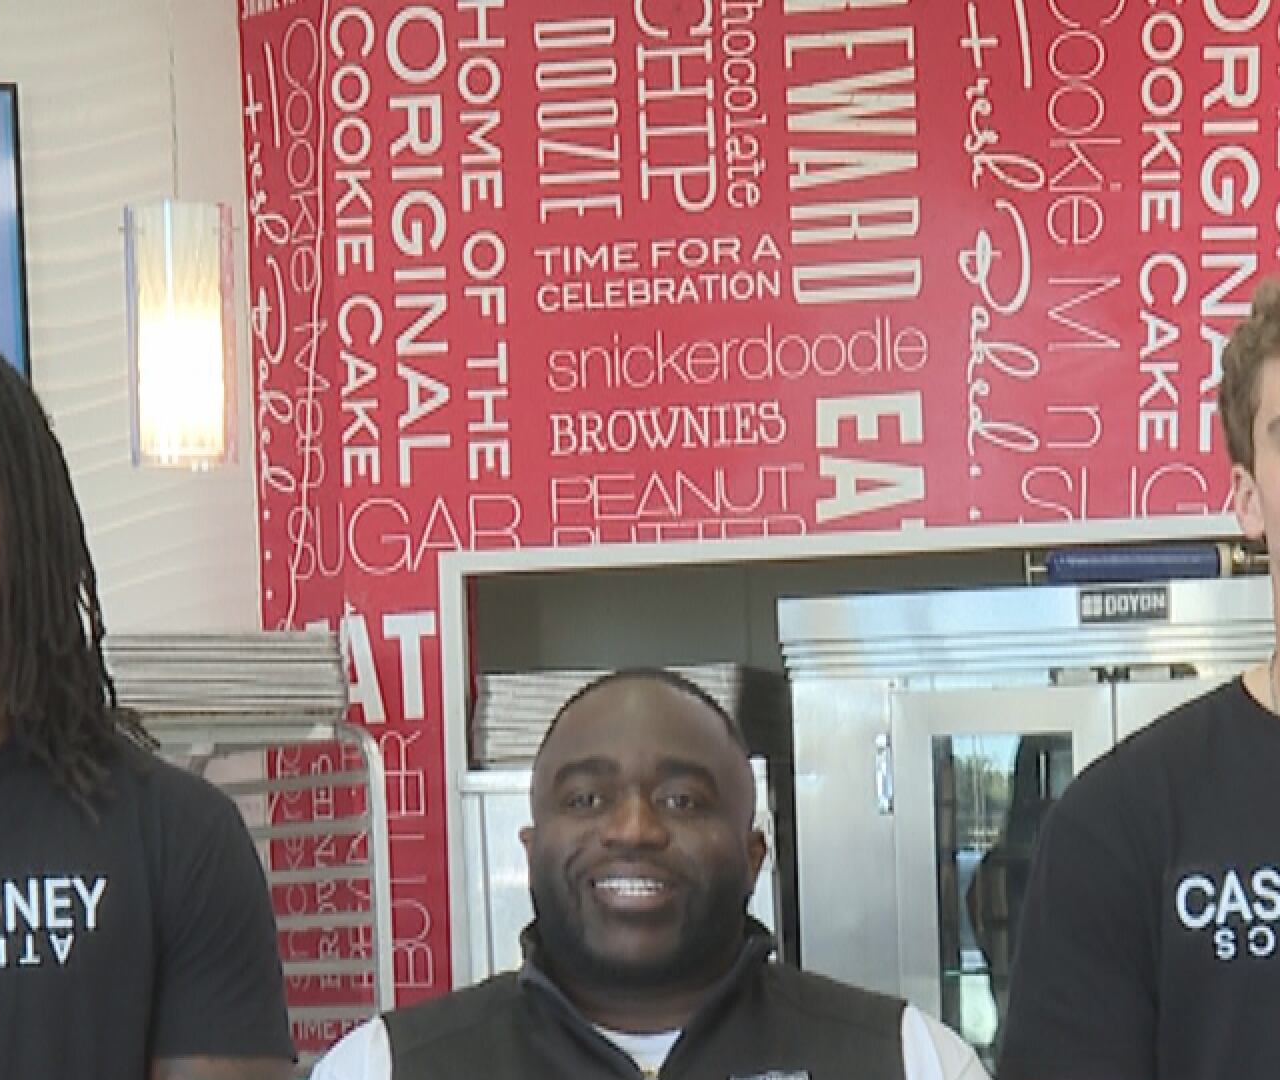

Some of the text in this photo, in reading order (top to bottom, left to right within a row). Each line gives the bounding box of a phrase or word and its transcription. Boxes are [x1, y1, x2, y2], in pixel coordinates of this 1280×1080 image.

[720, 0, 768, 208] hocolate
[328, 6, 384, 488] COOKIE CAKE
[385, 5, 452, 486] ORIGINAL
[456, 0, 512, 482] HOME OF THE
[533, 233, 782, 276] TIME FOR A
[1138, 0, 1189, 453] OOKIE CAKE
[535, 267, 781, 313] CELEBRATION
[547, 317, 928, 392] snickerdoodle
[548, 399, 788, 457] BROWNIES
[814, 389, 926, 532] EA
[550, 463, 806, 523] PEANUT
[1105, 591, 1166, 617] DOYON
[306, 610, 437, 725] AT
